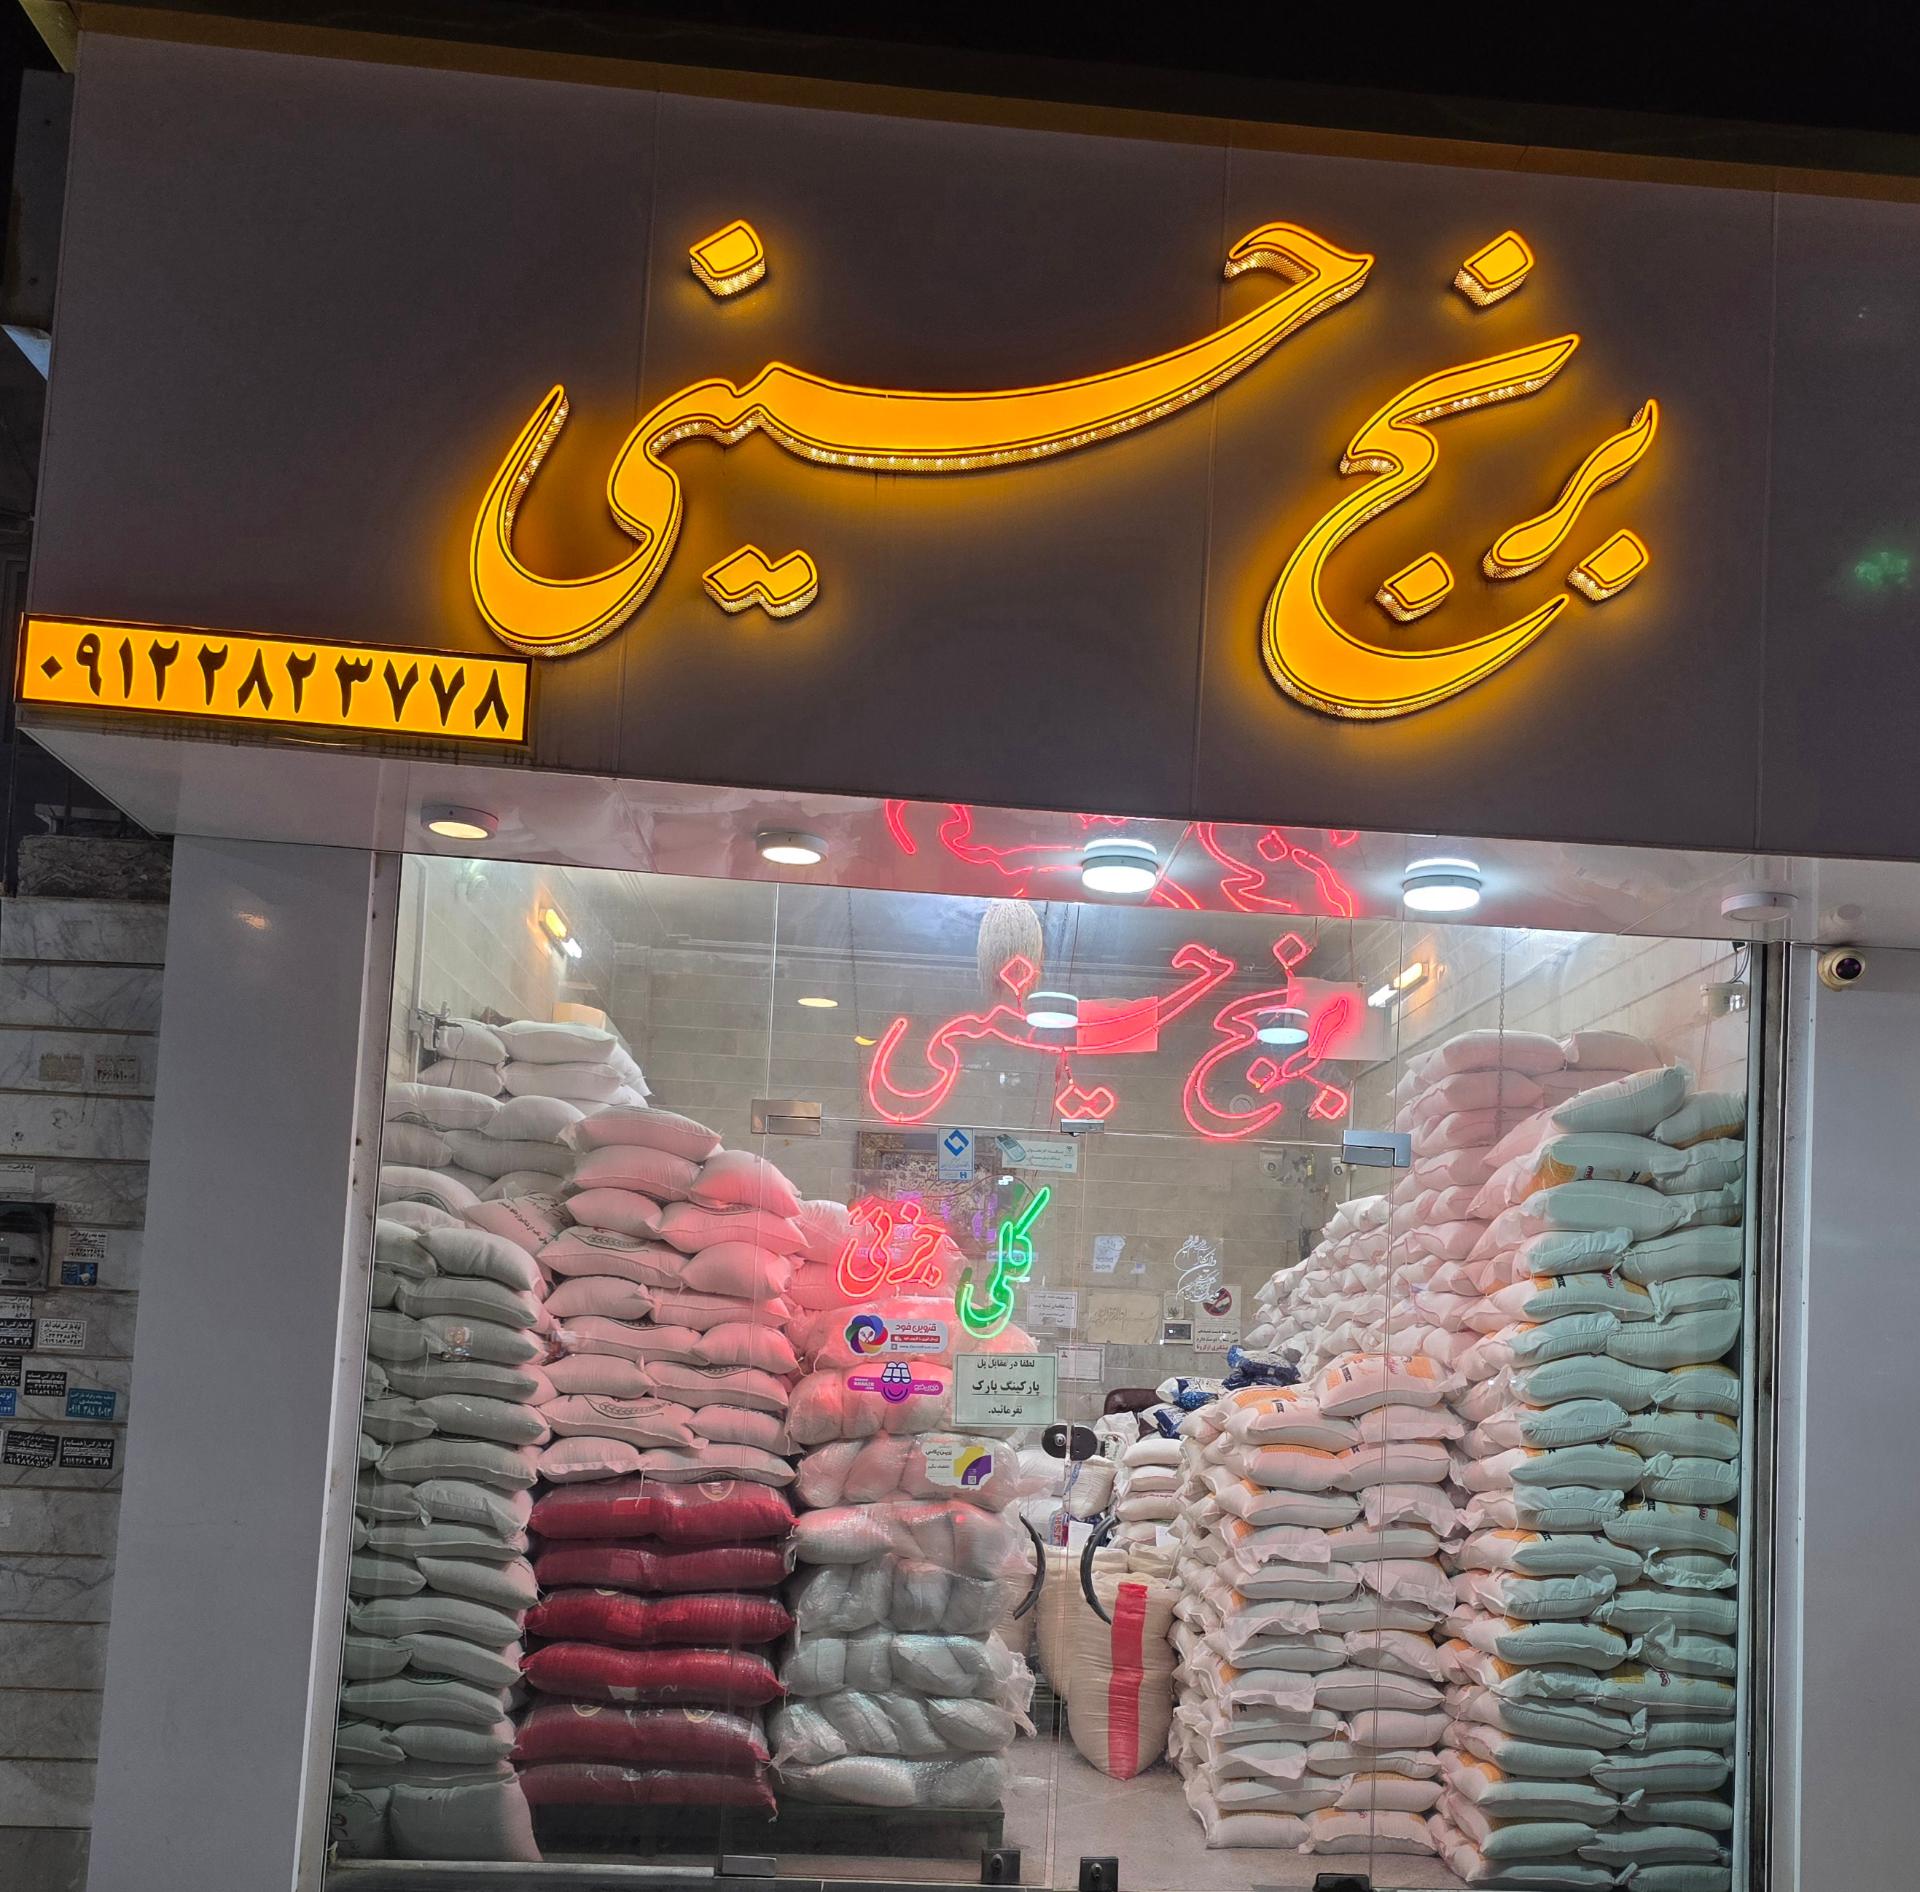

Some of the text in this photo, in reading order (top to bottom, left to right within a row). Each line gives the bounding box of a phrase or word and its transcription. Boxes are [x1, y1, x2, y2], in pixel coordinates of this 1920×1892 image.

[468, 217, 1660, 720] برنج حسینی
[40, 632, 510, 732] ۰۹۱۲۲۸۲۳۷۷۸
[895, 1322, 937, 1334] قزوین فود
[977, 1358, 1035, 1369] لطفا در مقابل پل
[972, 1379, 998, 1394] پارک
